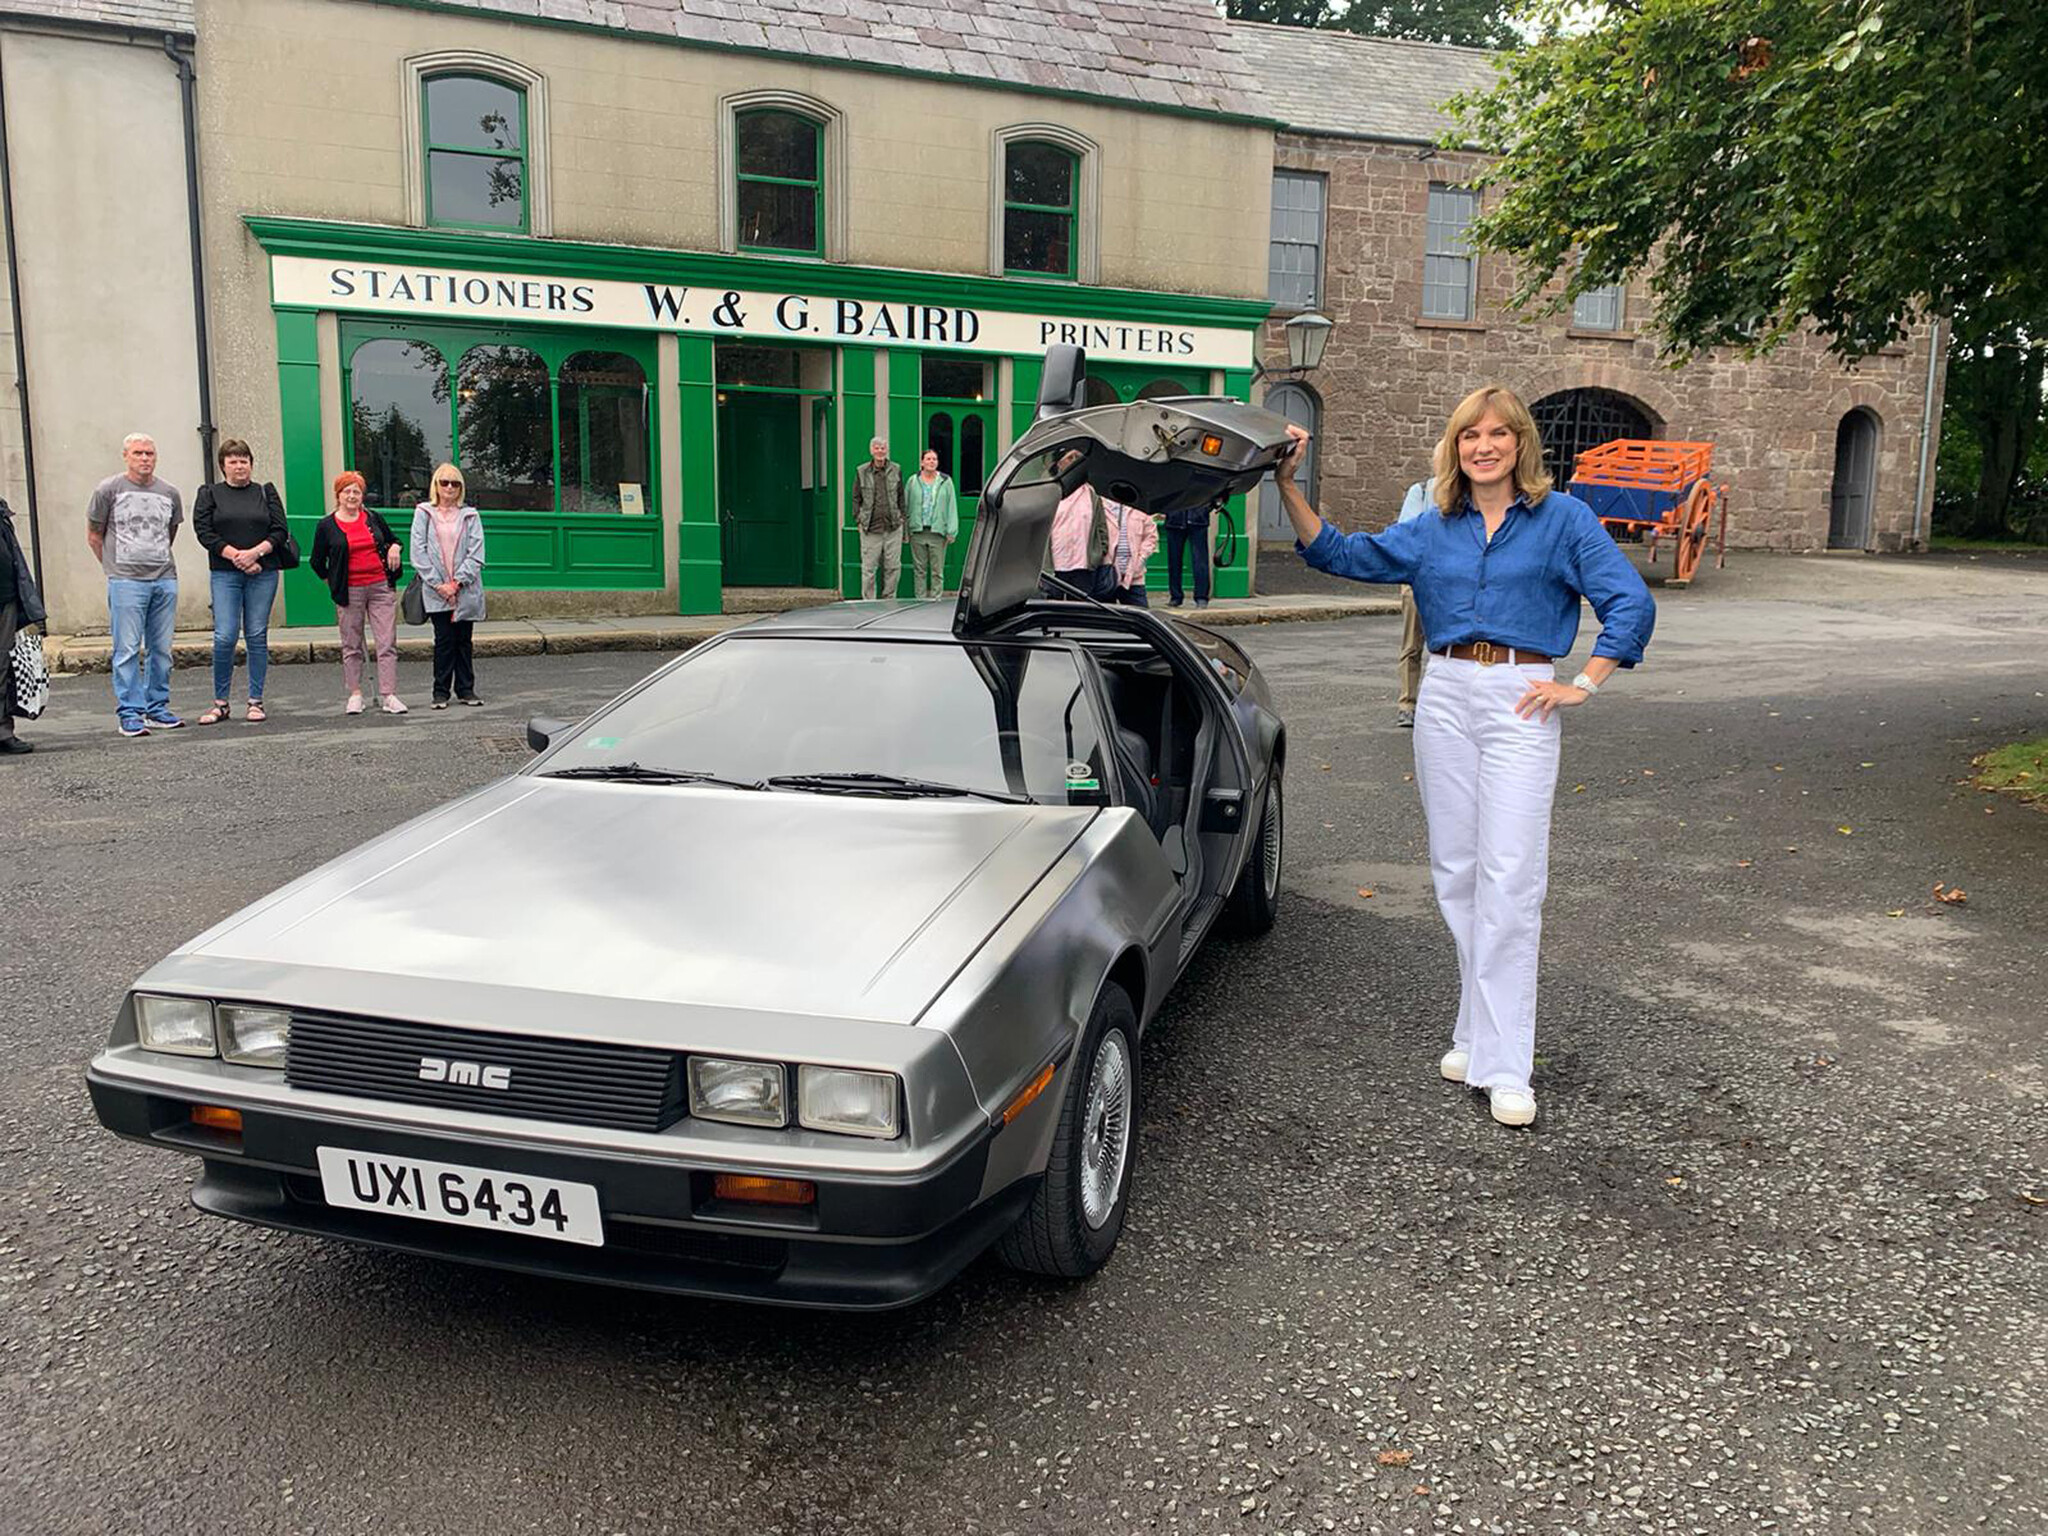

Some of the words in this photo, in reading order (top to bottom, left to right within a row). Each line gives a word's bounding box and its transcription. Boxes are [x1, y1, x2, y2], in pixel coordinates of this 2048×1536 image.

[330, 268, 594, 312] STATIONERS
[644, 284, 692, 325] W.
[711, 290, 748, 328] &
[776, 295, 820, 333] G.
[836, 299, 979, 344] BAIRD
[1040, 321, 1195, 354] PRINTERS
[437, 1172, 569, 1232] 6434
